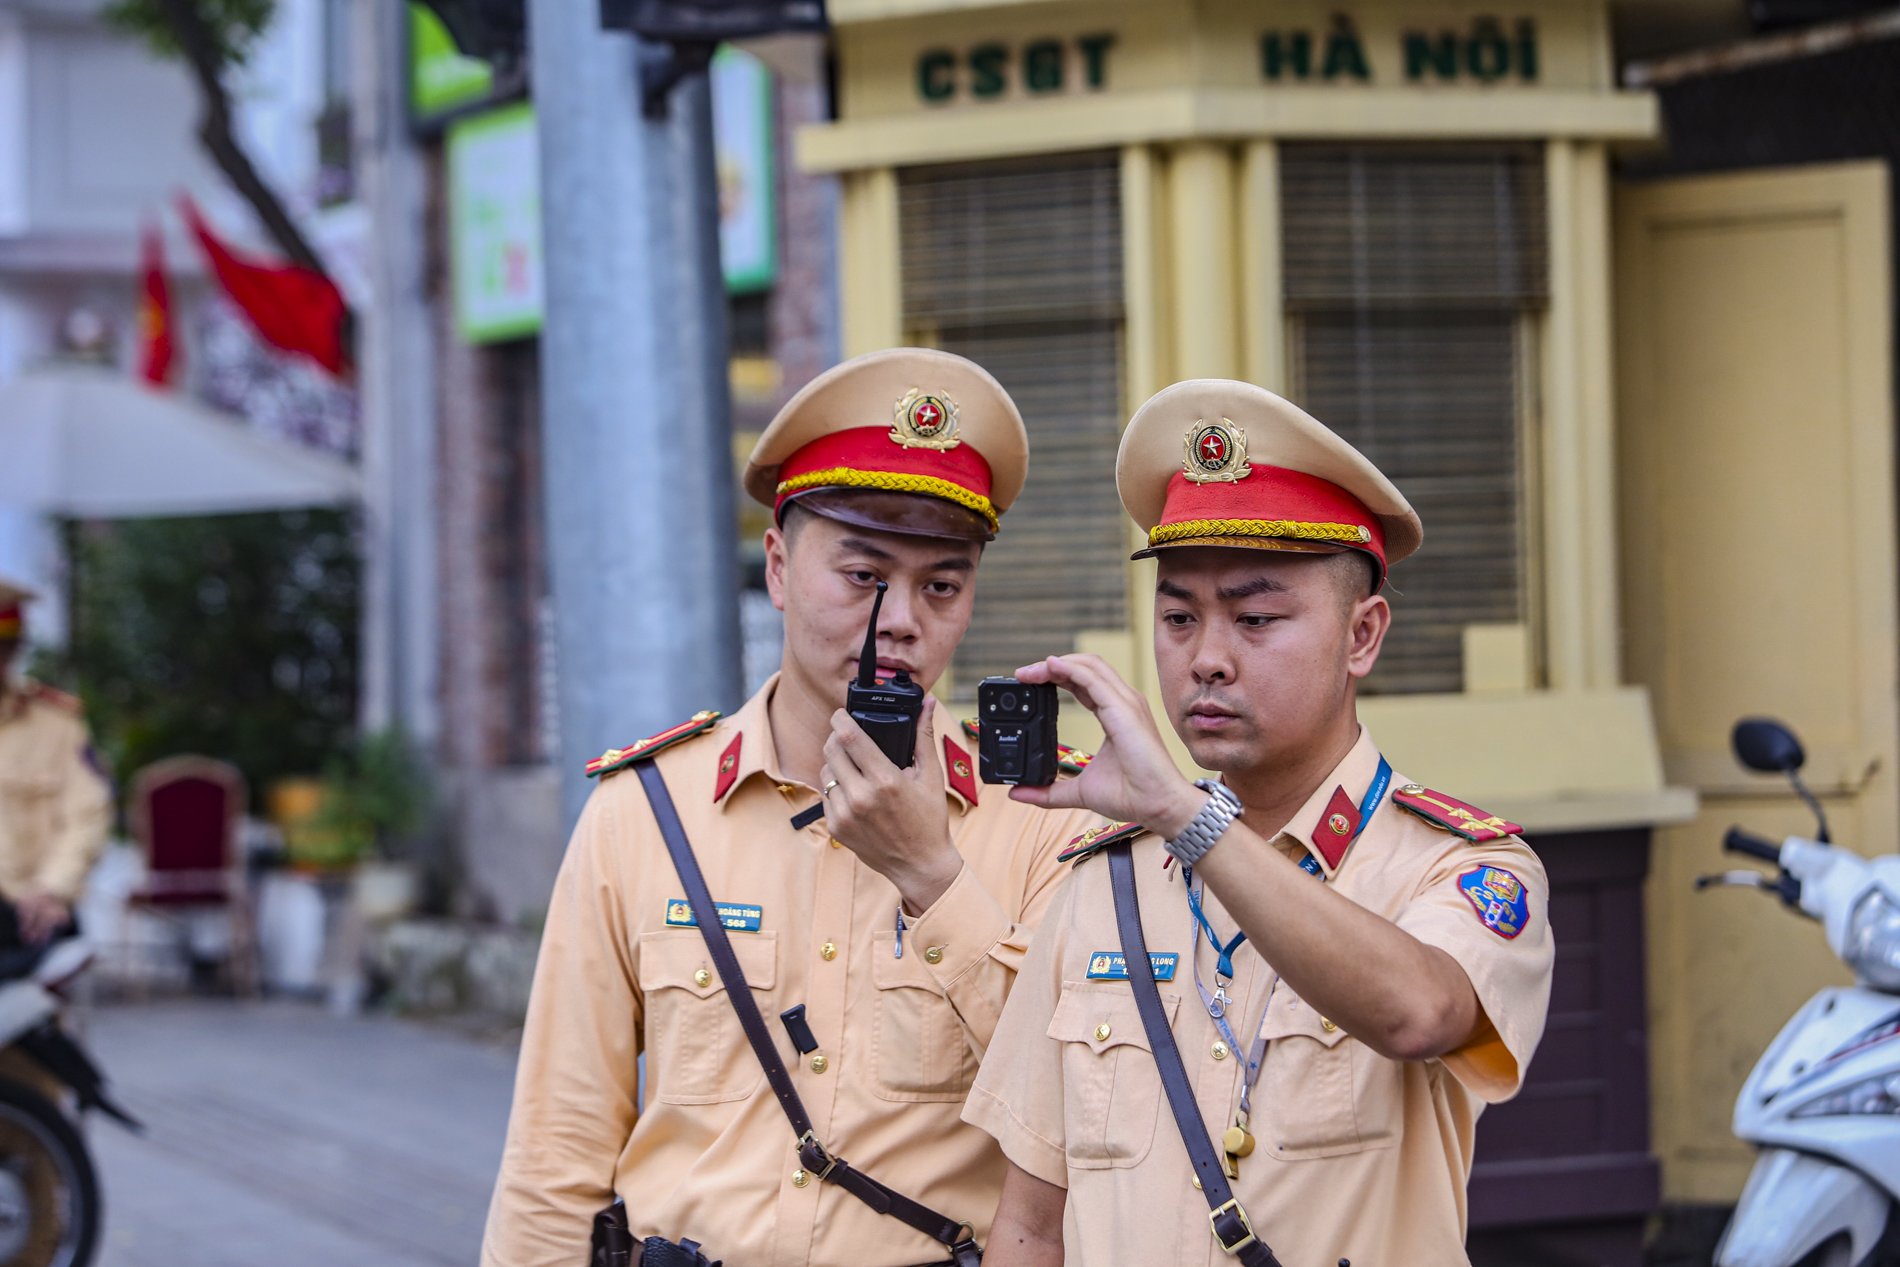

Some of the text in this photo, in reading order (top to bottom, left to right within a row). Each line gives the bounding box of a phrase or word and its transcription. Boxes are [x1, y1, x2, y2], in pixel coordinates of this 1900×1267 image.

[918, 32, 1117, 105] CSGT
[1260, 11, 1371, 83] HÀ
[1113, 957, 1126, 967] PHẠ
[1156, 957, 1174, 965] LONG
